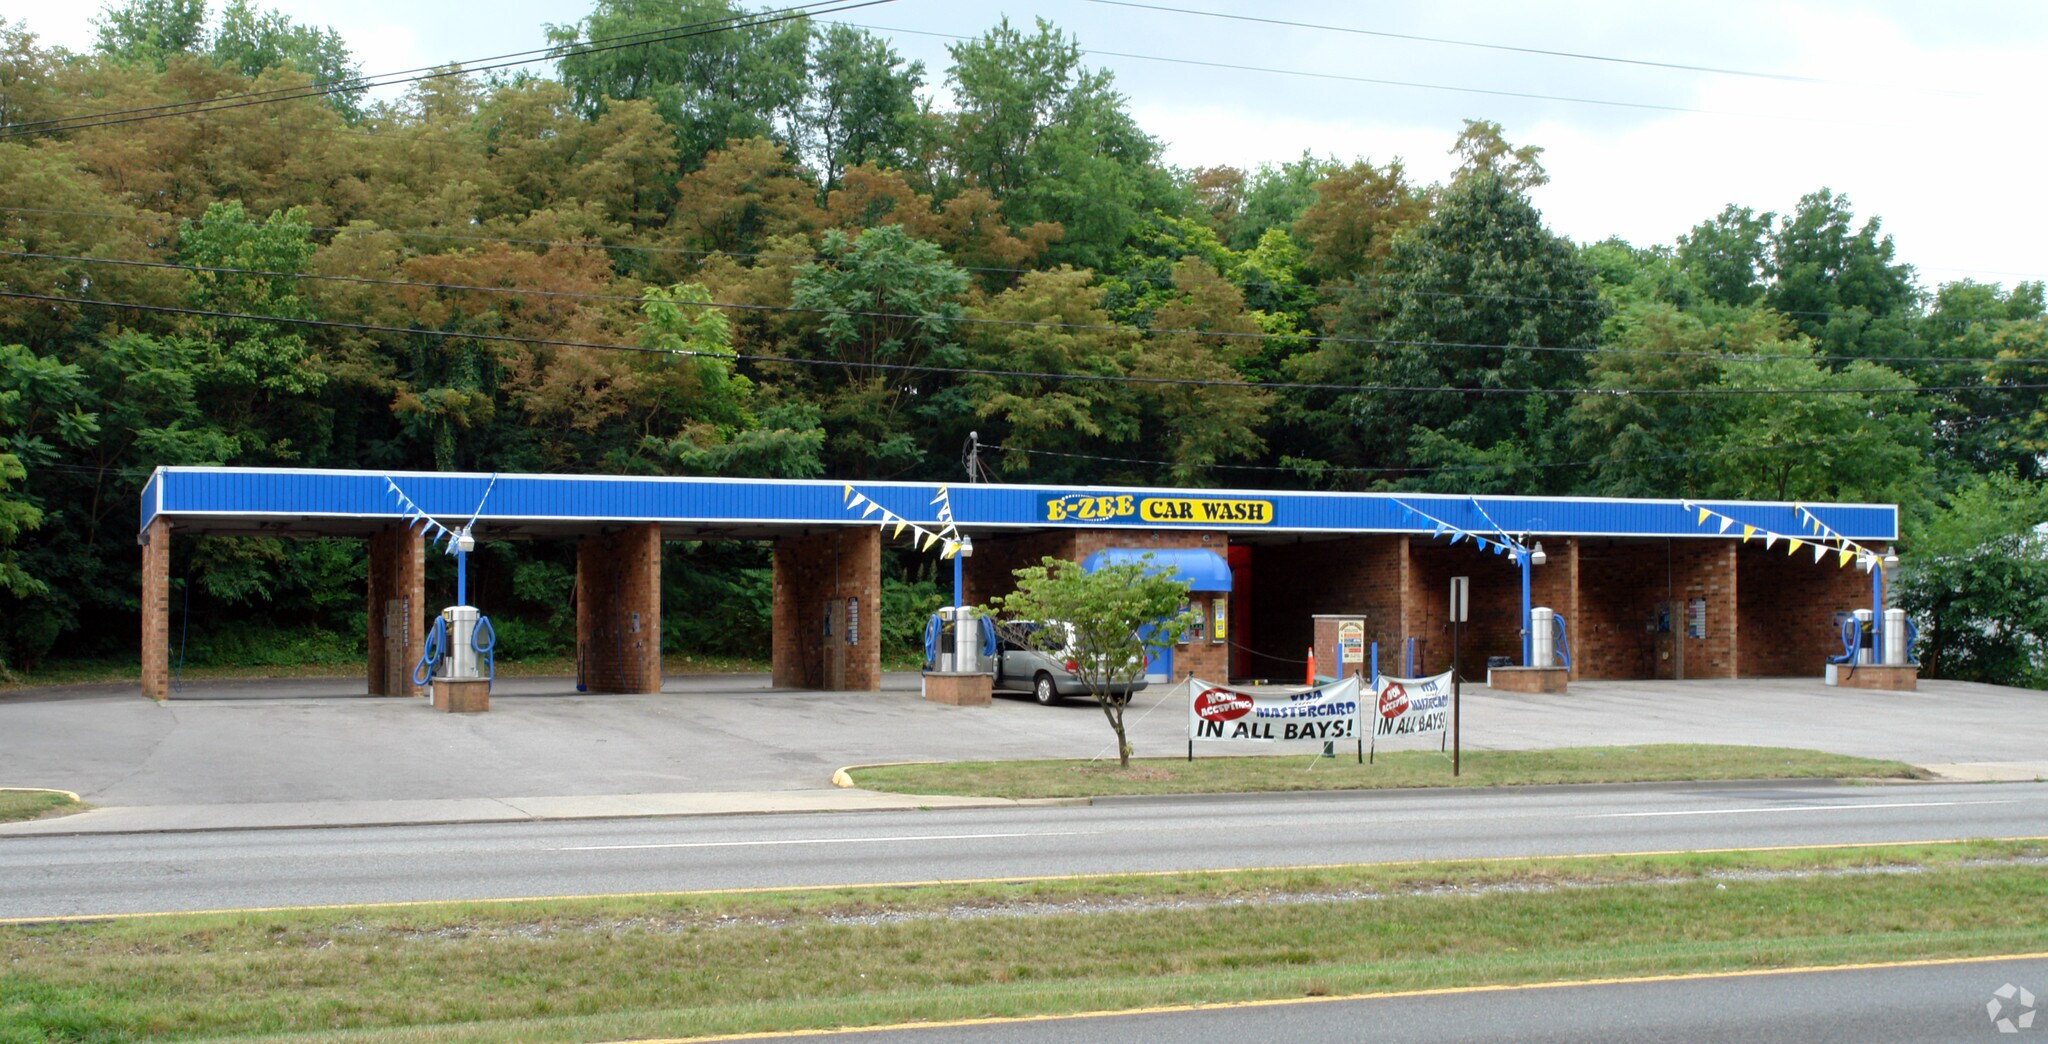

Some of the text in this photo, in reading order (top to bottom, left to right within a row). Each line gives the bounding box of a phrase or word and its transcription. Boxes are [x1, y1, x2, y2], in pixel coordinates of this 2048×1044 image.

[1046, 494, 1264, 521] E-ZEE CAR WASH
[1206, 691, 1237, 704] NOW
[1290, 690, 1323, 702] VISA
[1201, 700, 1252, 717] ACCEPTING
[1256, 701, 1357, 719] MASTERCARD
[1197, 719, 1353, 740] IN ALL BAYS!
[1378, 711, 1446, 736] IN ALL BAYS!
